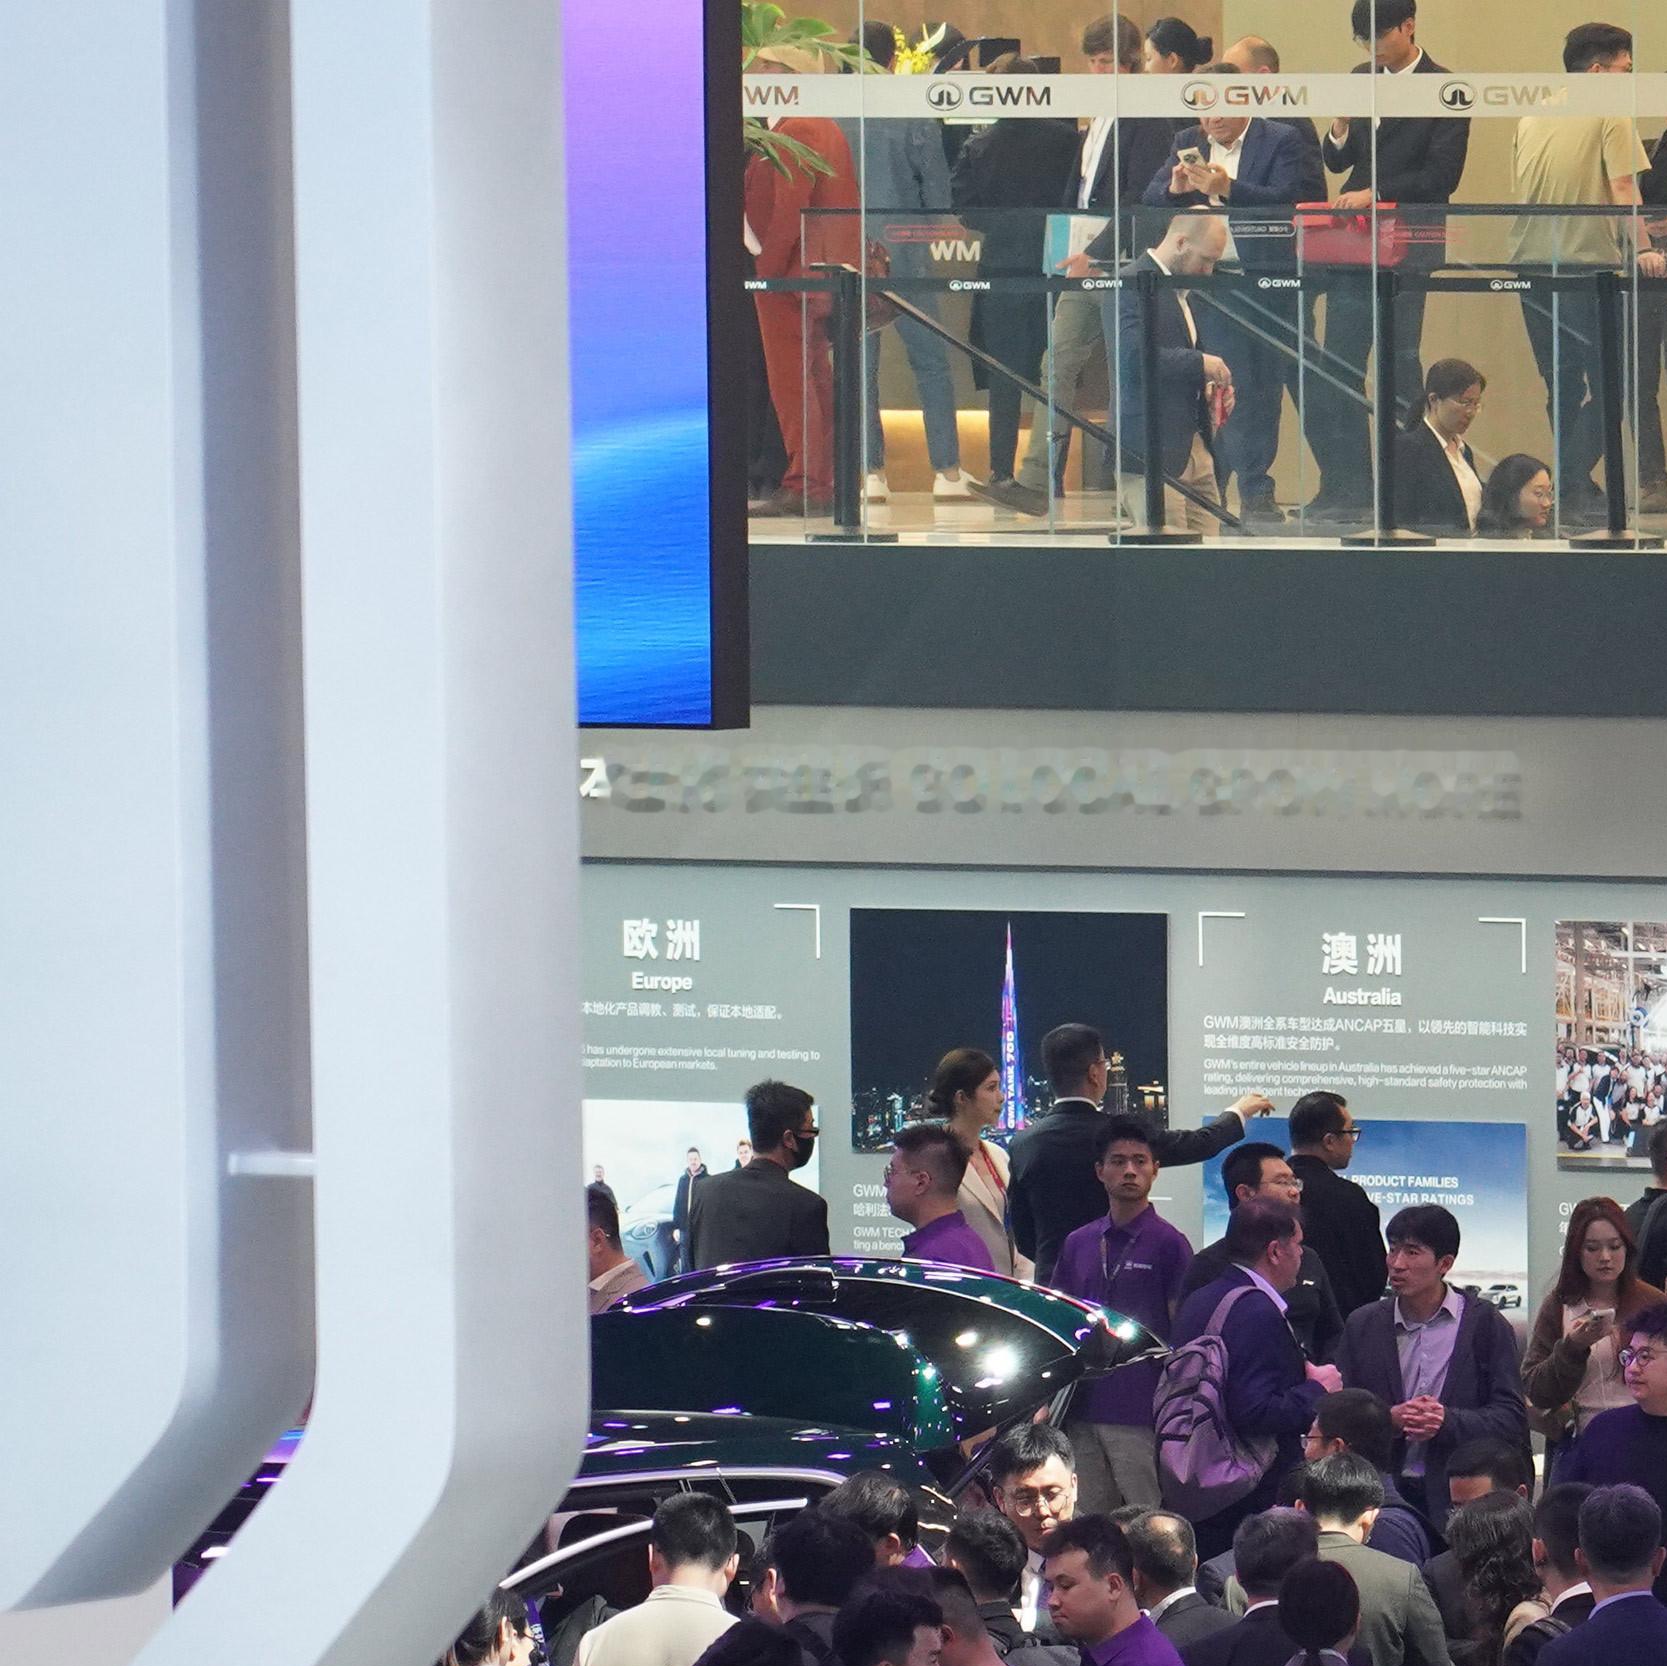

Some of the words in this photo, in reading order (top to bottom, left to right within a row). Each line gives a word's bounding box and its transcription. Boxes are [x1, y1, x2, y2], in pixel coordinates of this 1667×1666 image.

[743, 85, 799, 106] WM
[969, 85, 1051, 106] GWM
[1225, 85, 1308, 106] GWM
[930, 241, 981, 261] WM
[964, 280, 991, 290] GWM
[1096, 279, 1123, 289] GWM
[1272, 278, 1301, 288] GWM
[1504, 280, 1532, 290] GWM
[623, 918, 701, 962] 欧洲
[1321, 931, 1402, 976] 澳洲
[631, 971, 694, 994] Europe
[1322, 986, 1402, 1007] Australia
[758, 1048, 776, 1059] and
[778, 1049, 809, 1062] testing
[811, 1050, 821, 1060] to
[633, 1059, 678, 1072] European
[1490, 1065, 1528, 1077] ANCAP
[1507, 1079, 1528, 1089] with
[1350, 1174, 1405, 1188] PRODUCT
[1407, 1175, 1459, 1189] FAMILIES
[1420, 1193, 1475, 1206] RATINGS
[853, 1226, 881, 1239] GWM
